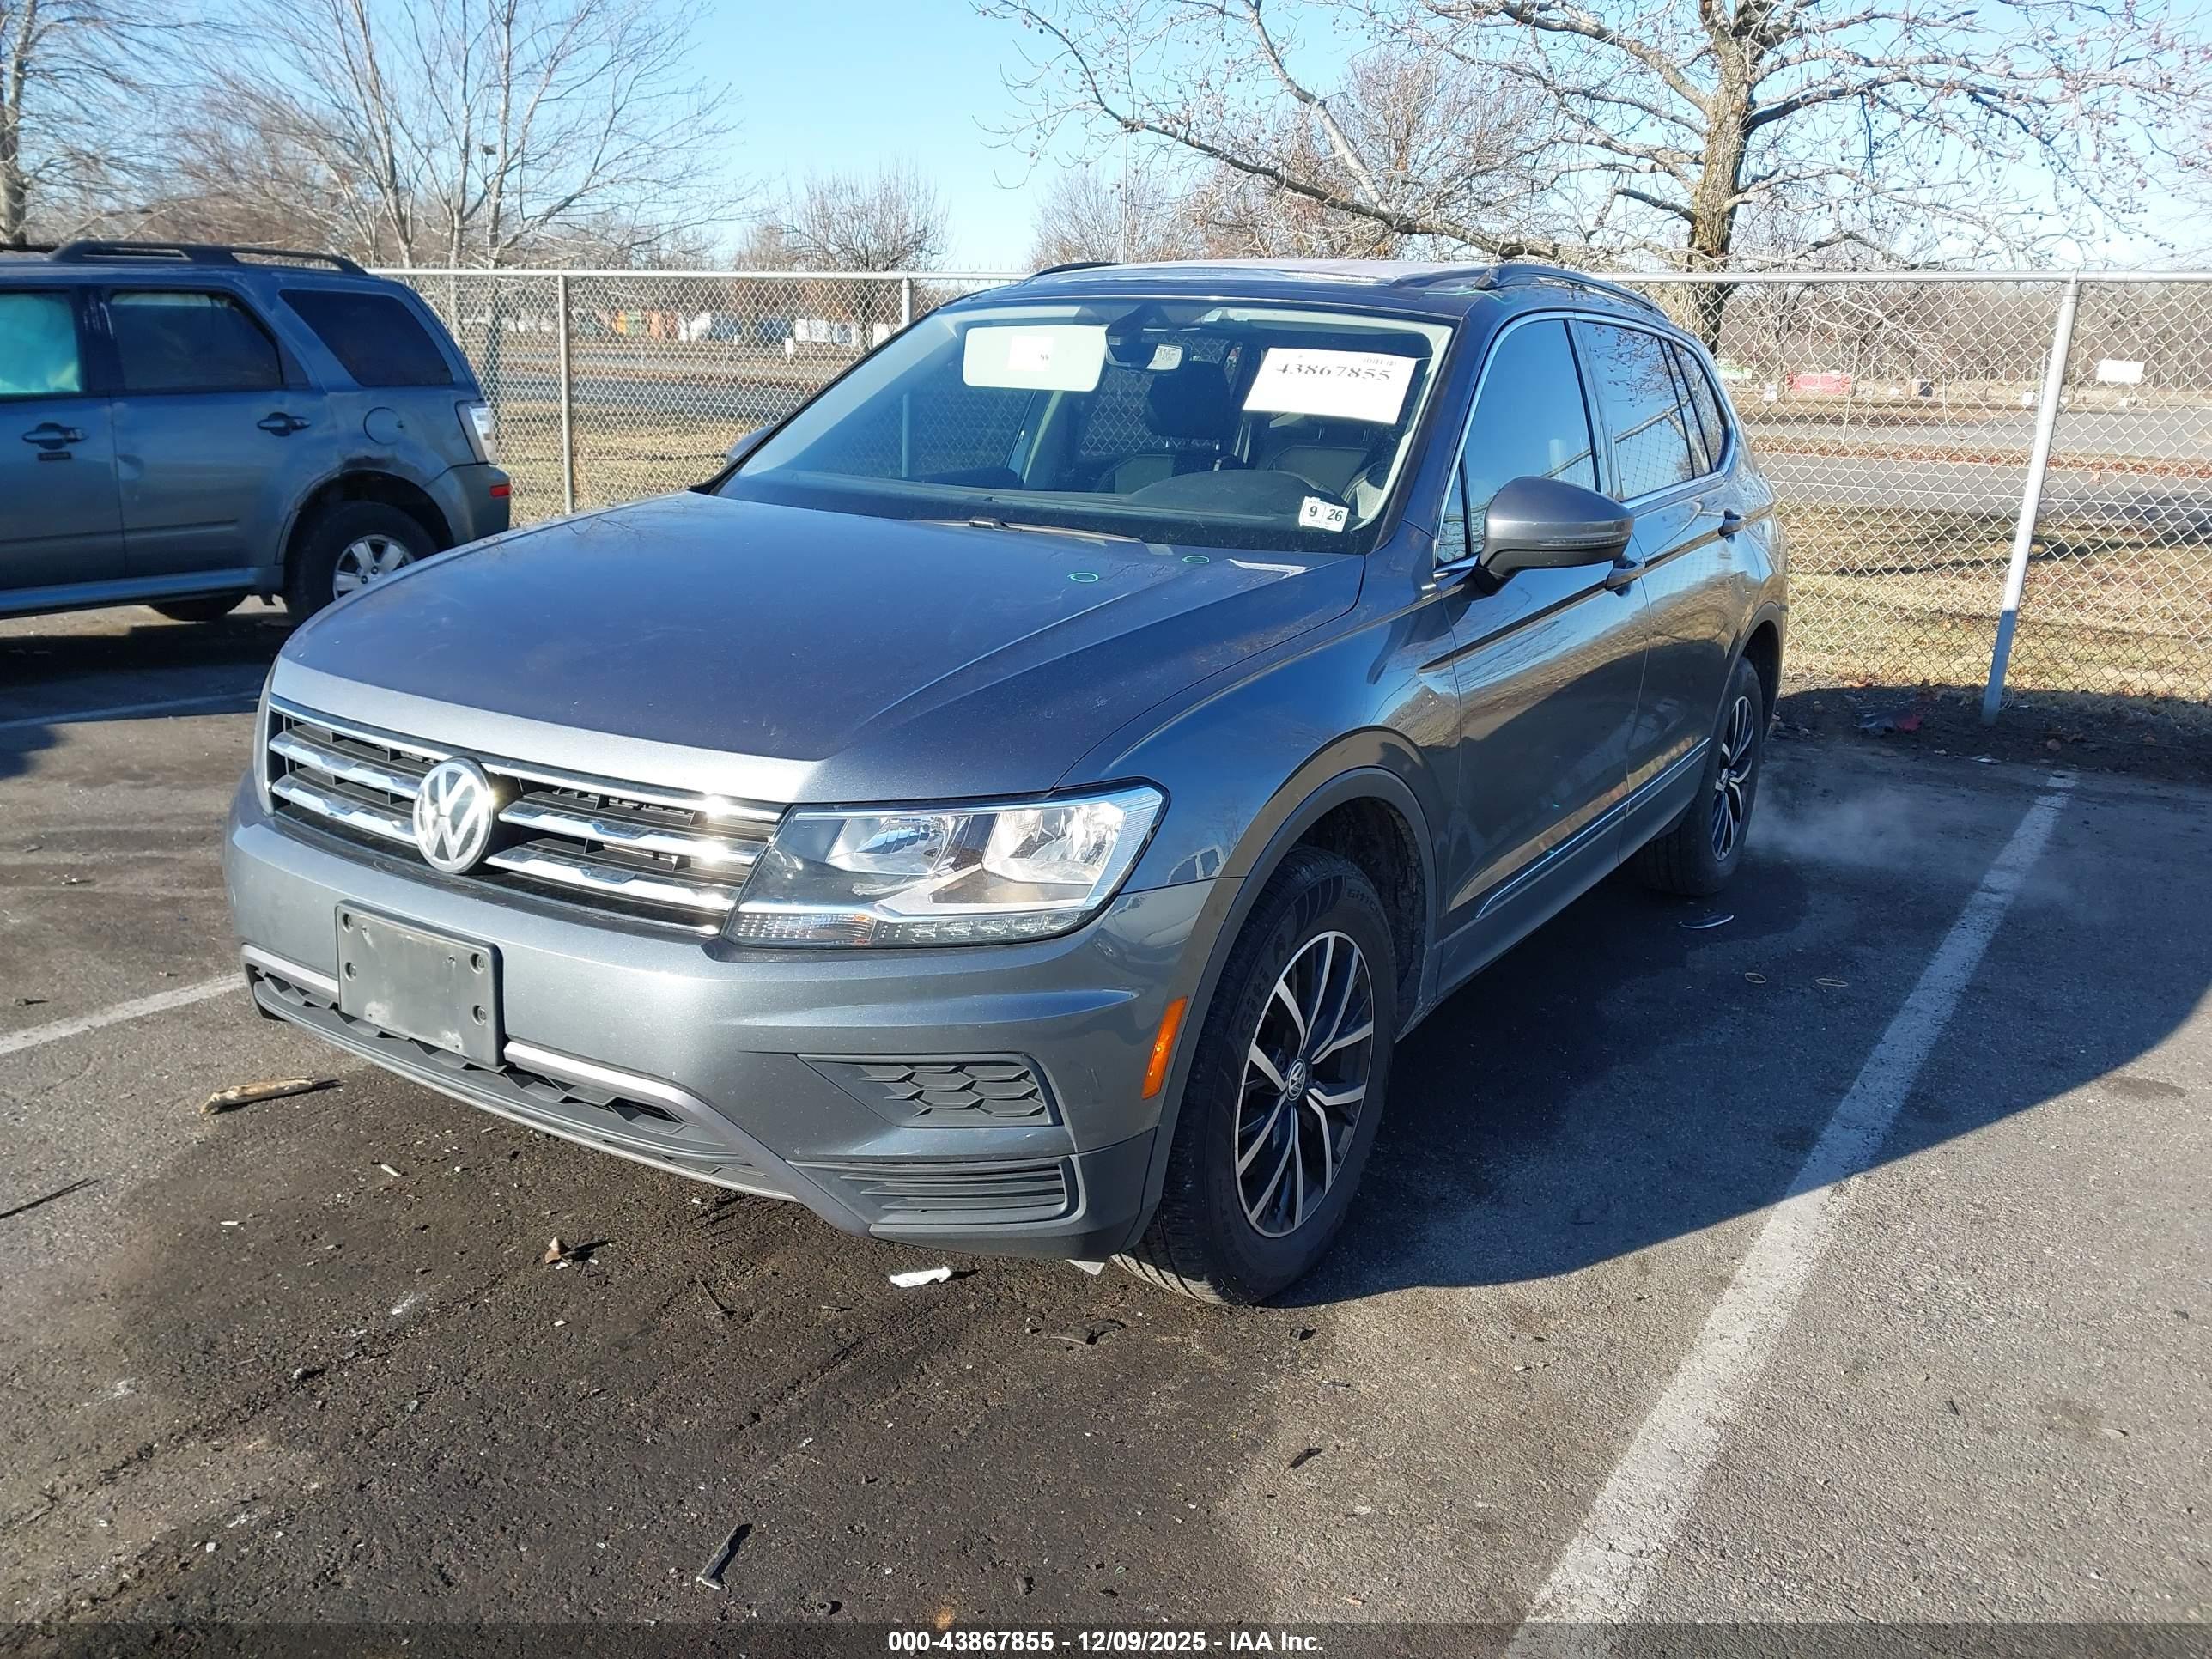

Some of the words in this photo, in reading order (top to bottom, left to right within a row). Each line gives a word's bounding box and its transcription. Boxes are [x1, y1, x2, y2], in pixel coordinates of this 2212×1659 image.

[1276, 362, 1392, 381] 43867855
[1309, 505, 1318, 517] 9
[1327, 508, 1344, 522] 26
